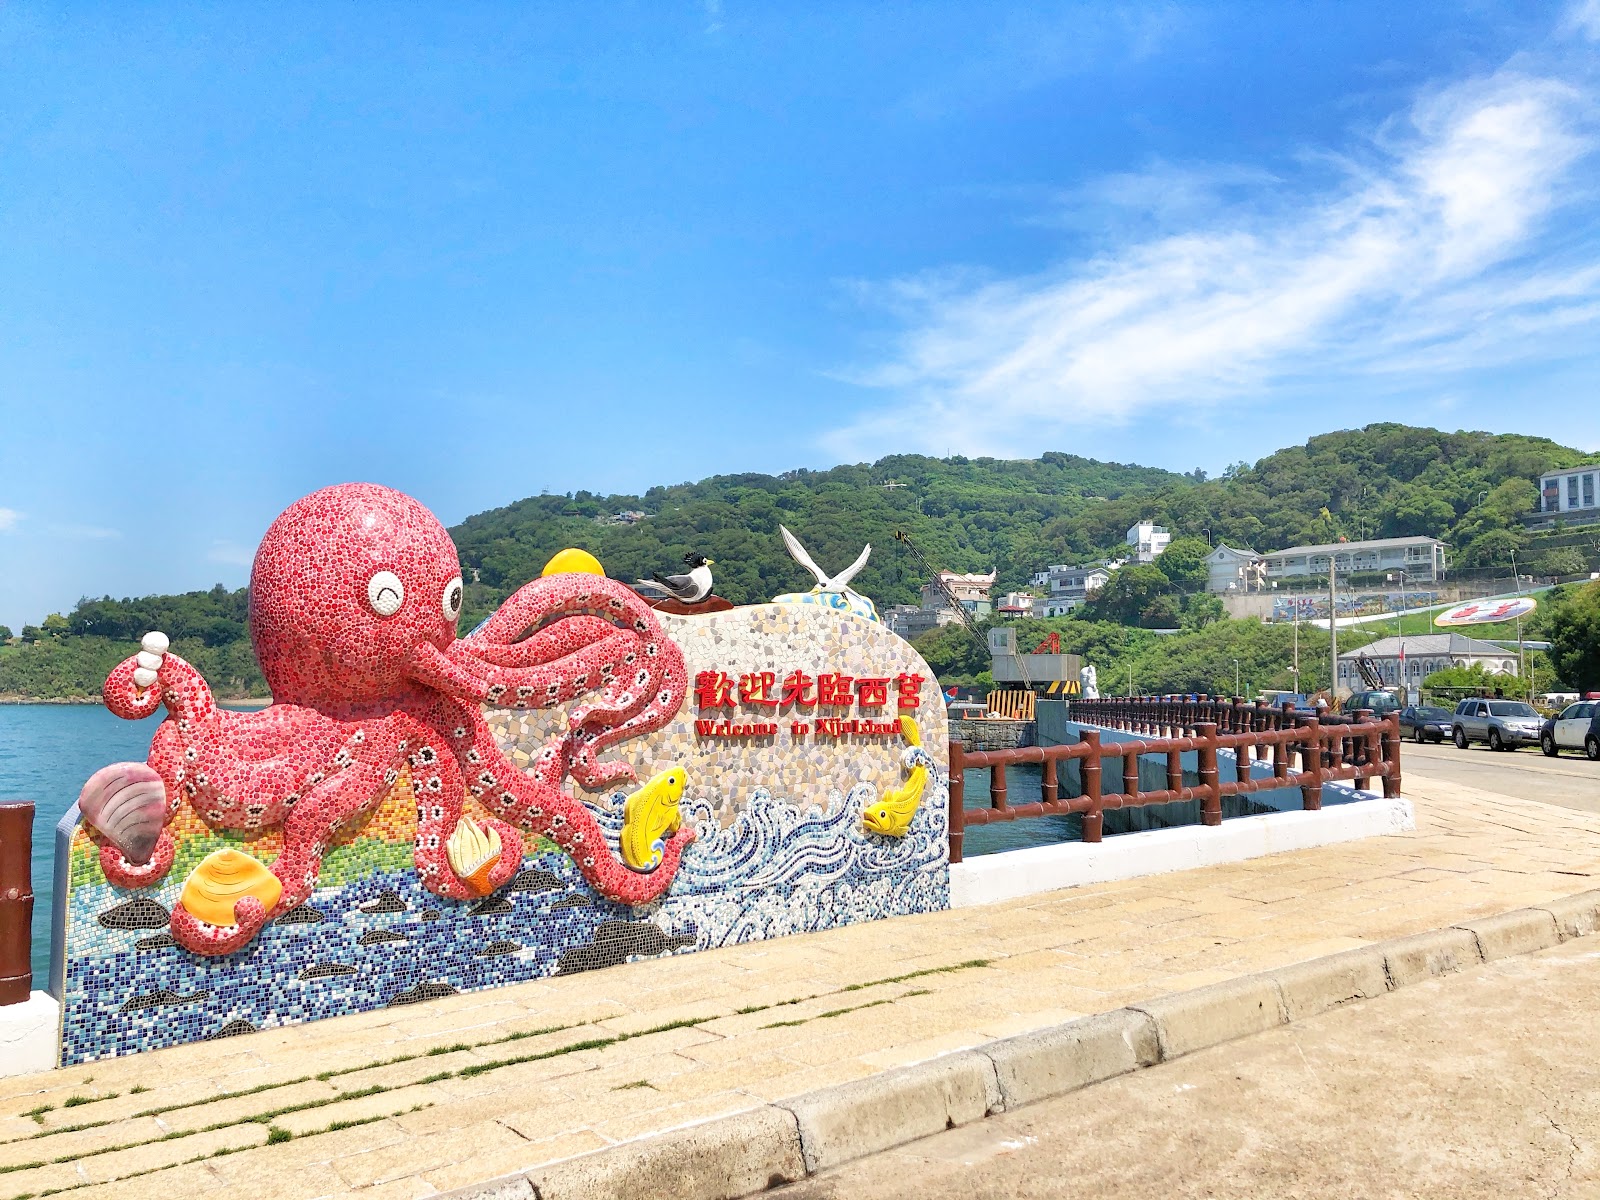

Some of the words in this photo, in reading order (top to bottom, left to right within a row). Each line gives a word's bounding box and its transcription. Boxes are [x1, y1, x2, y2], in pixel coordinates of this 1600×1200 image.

[694, 669, 925, 709] 歡迎光臨西莒
[695, 719, 778, 736] Welcome
[791, 720, 809, 735] to
